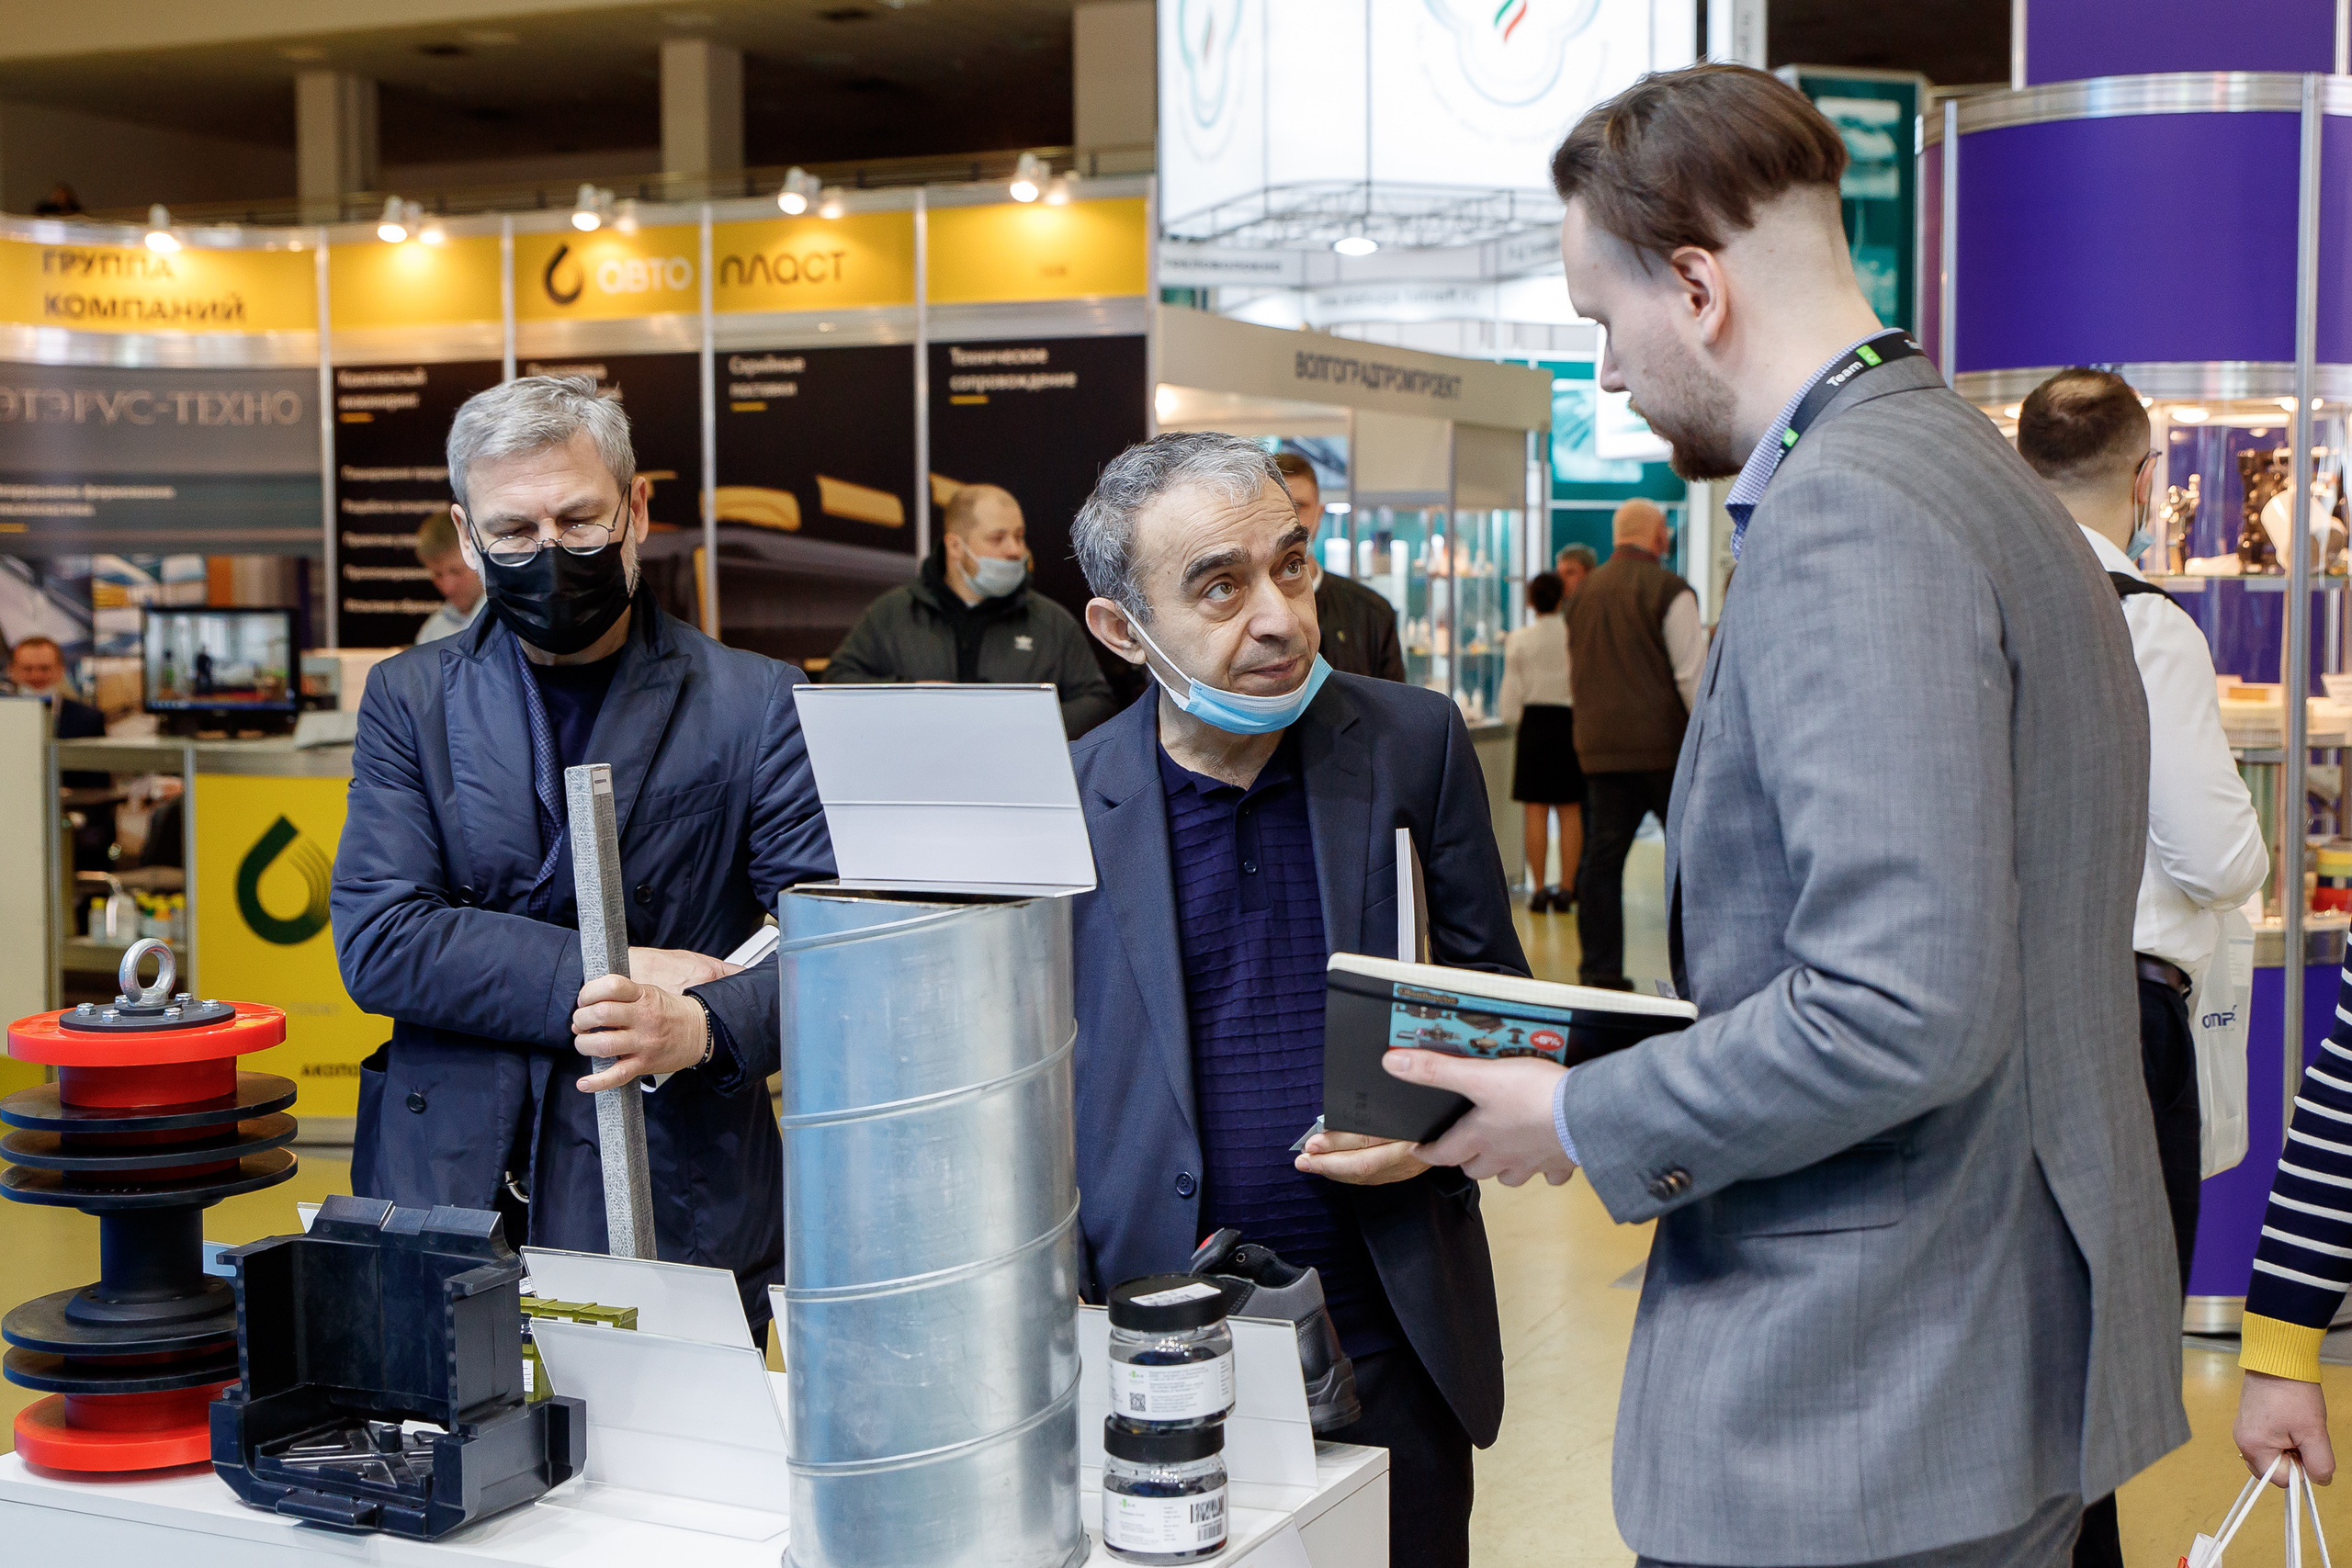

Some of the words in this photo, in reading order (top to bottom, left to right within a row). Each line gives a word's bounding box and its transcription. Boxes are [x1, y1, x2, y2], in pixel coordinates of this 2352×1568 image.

[42, 250, 176, 278] ГРУППА
[43, 292, 247, 321] КОМПАНИЙ
[1826, 360, 1864, 387] Team
